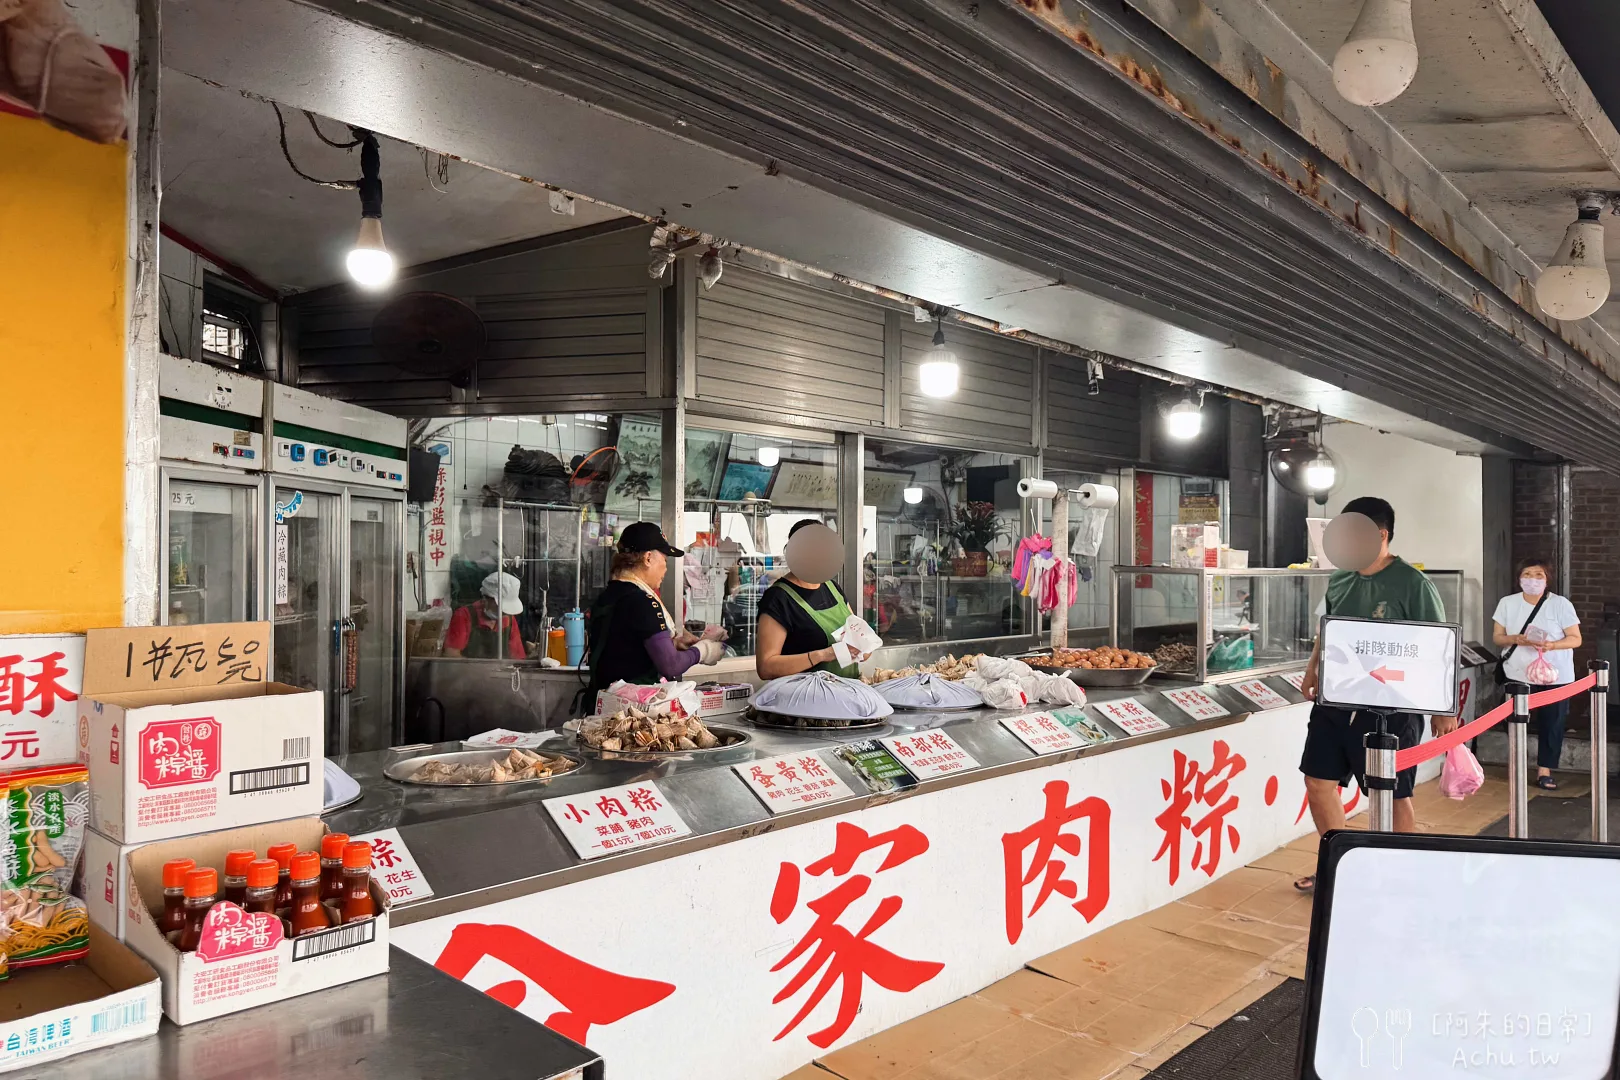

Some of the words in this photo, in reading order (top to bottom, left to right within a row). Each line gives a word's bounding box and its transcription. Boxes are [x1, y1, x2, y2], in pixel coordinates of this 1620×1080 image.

[171, 492, 182, 504] 25
[185, 493, 195, 506] 元
[1355, 639, 1419, 659] 排隊動線
[0, 651, 78, 718] 酥
[1, 730, 40, 761] 元
[893, 733, 954, 758] 南部粽
[750, 756, 828, 788] 蛋黃粽
[785, 786, 803, 795] 花生
[791, 789, 831, 802] 一個50元
[563, 787, 663, 824] 小肉粽
[625, 816, 655, 829] 豬肉
[591, 835, 633, 849] 一個15元
[634, 825, 676, 840] 7個100元
[384, 870, 417, 884] 花生
[15, 1046, 46, 1057] TAIWAN
[48, 1040, 70, 1050] BEER
